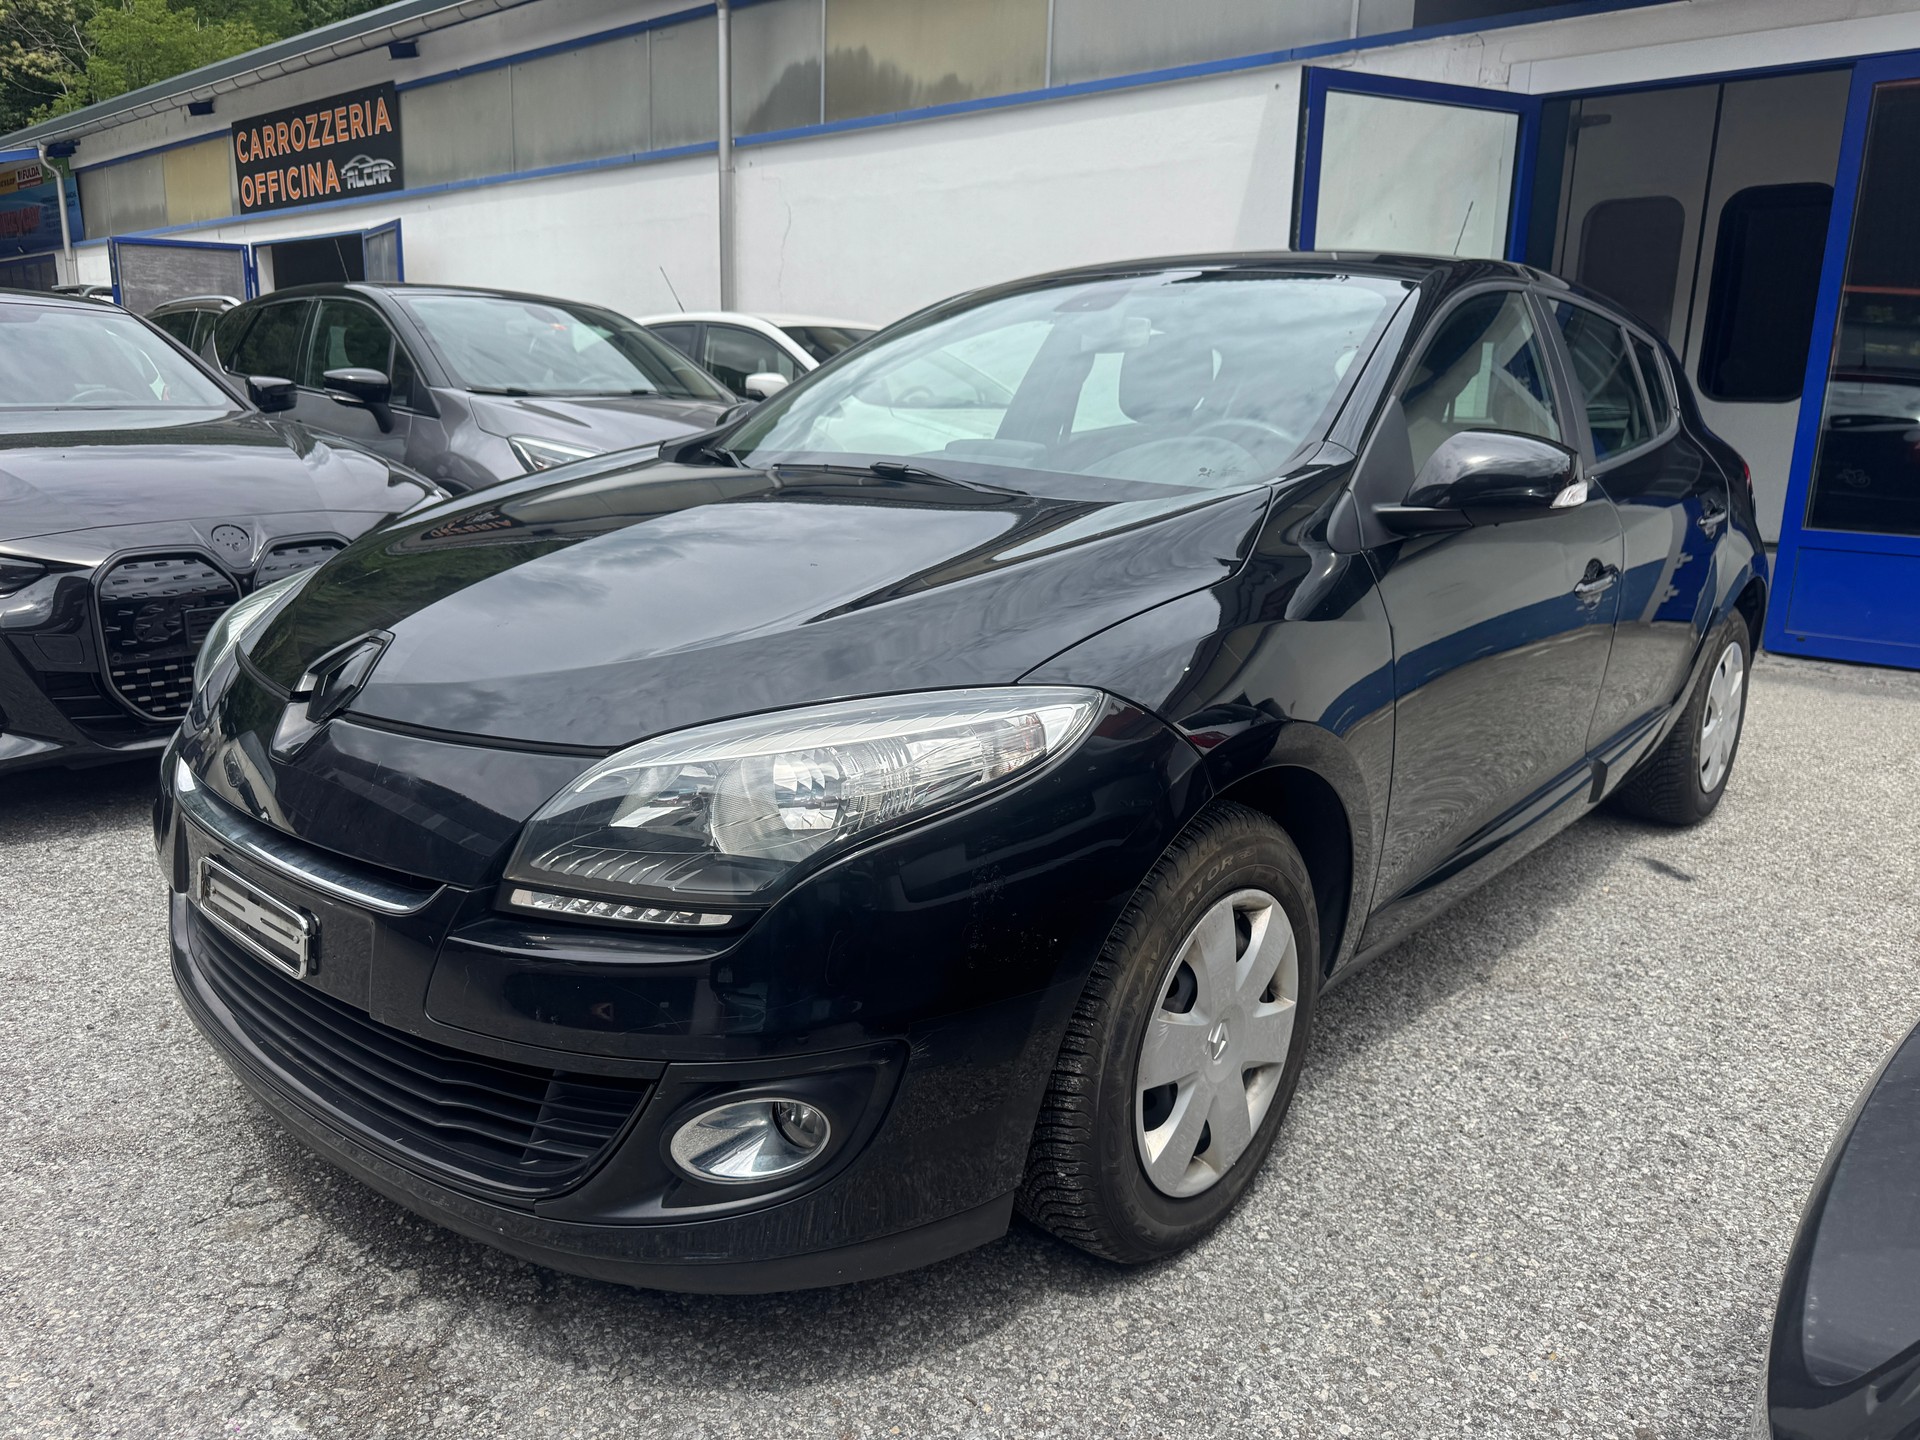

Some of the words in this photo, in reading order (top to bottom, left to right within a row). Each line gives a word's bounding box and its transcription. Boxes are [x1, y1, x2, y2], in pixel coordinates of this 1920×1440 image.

[236, 96, 393, 164] CARROZZERIA
[240, 159, 341, 207] OFFICINA
[346, 165, 392, 190] ALCAR
